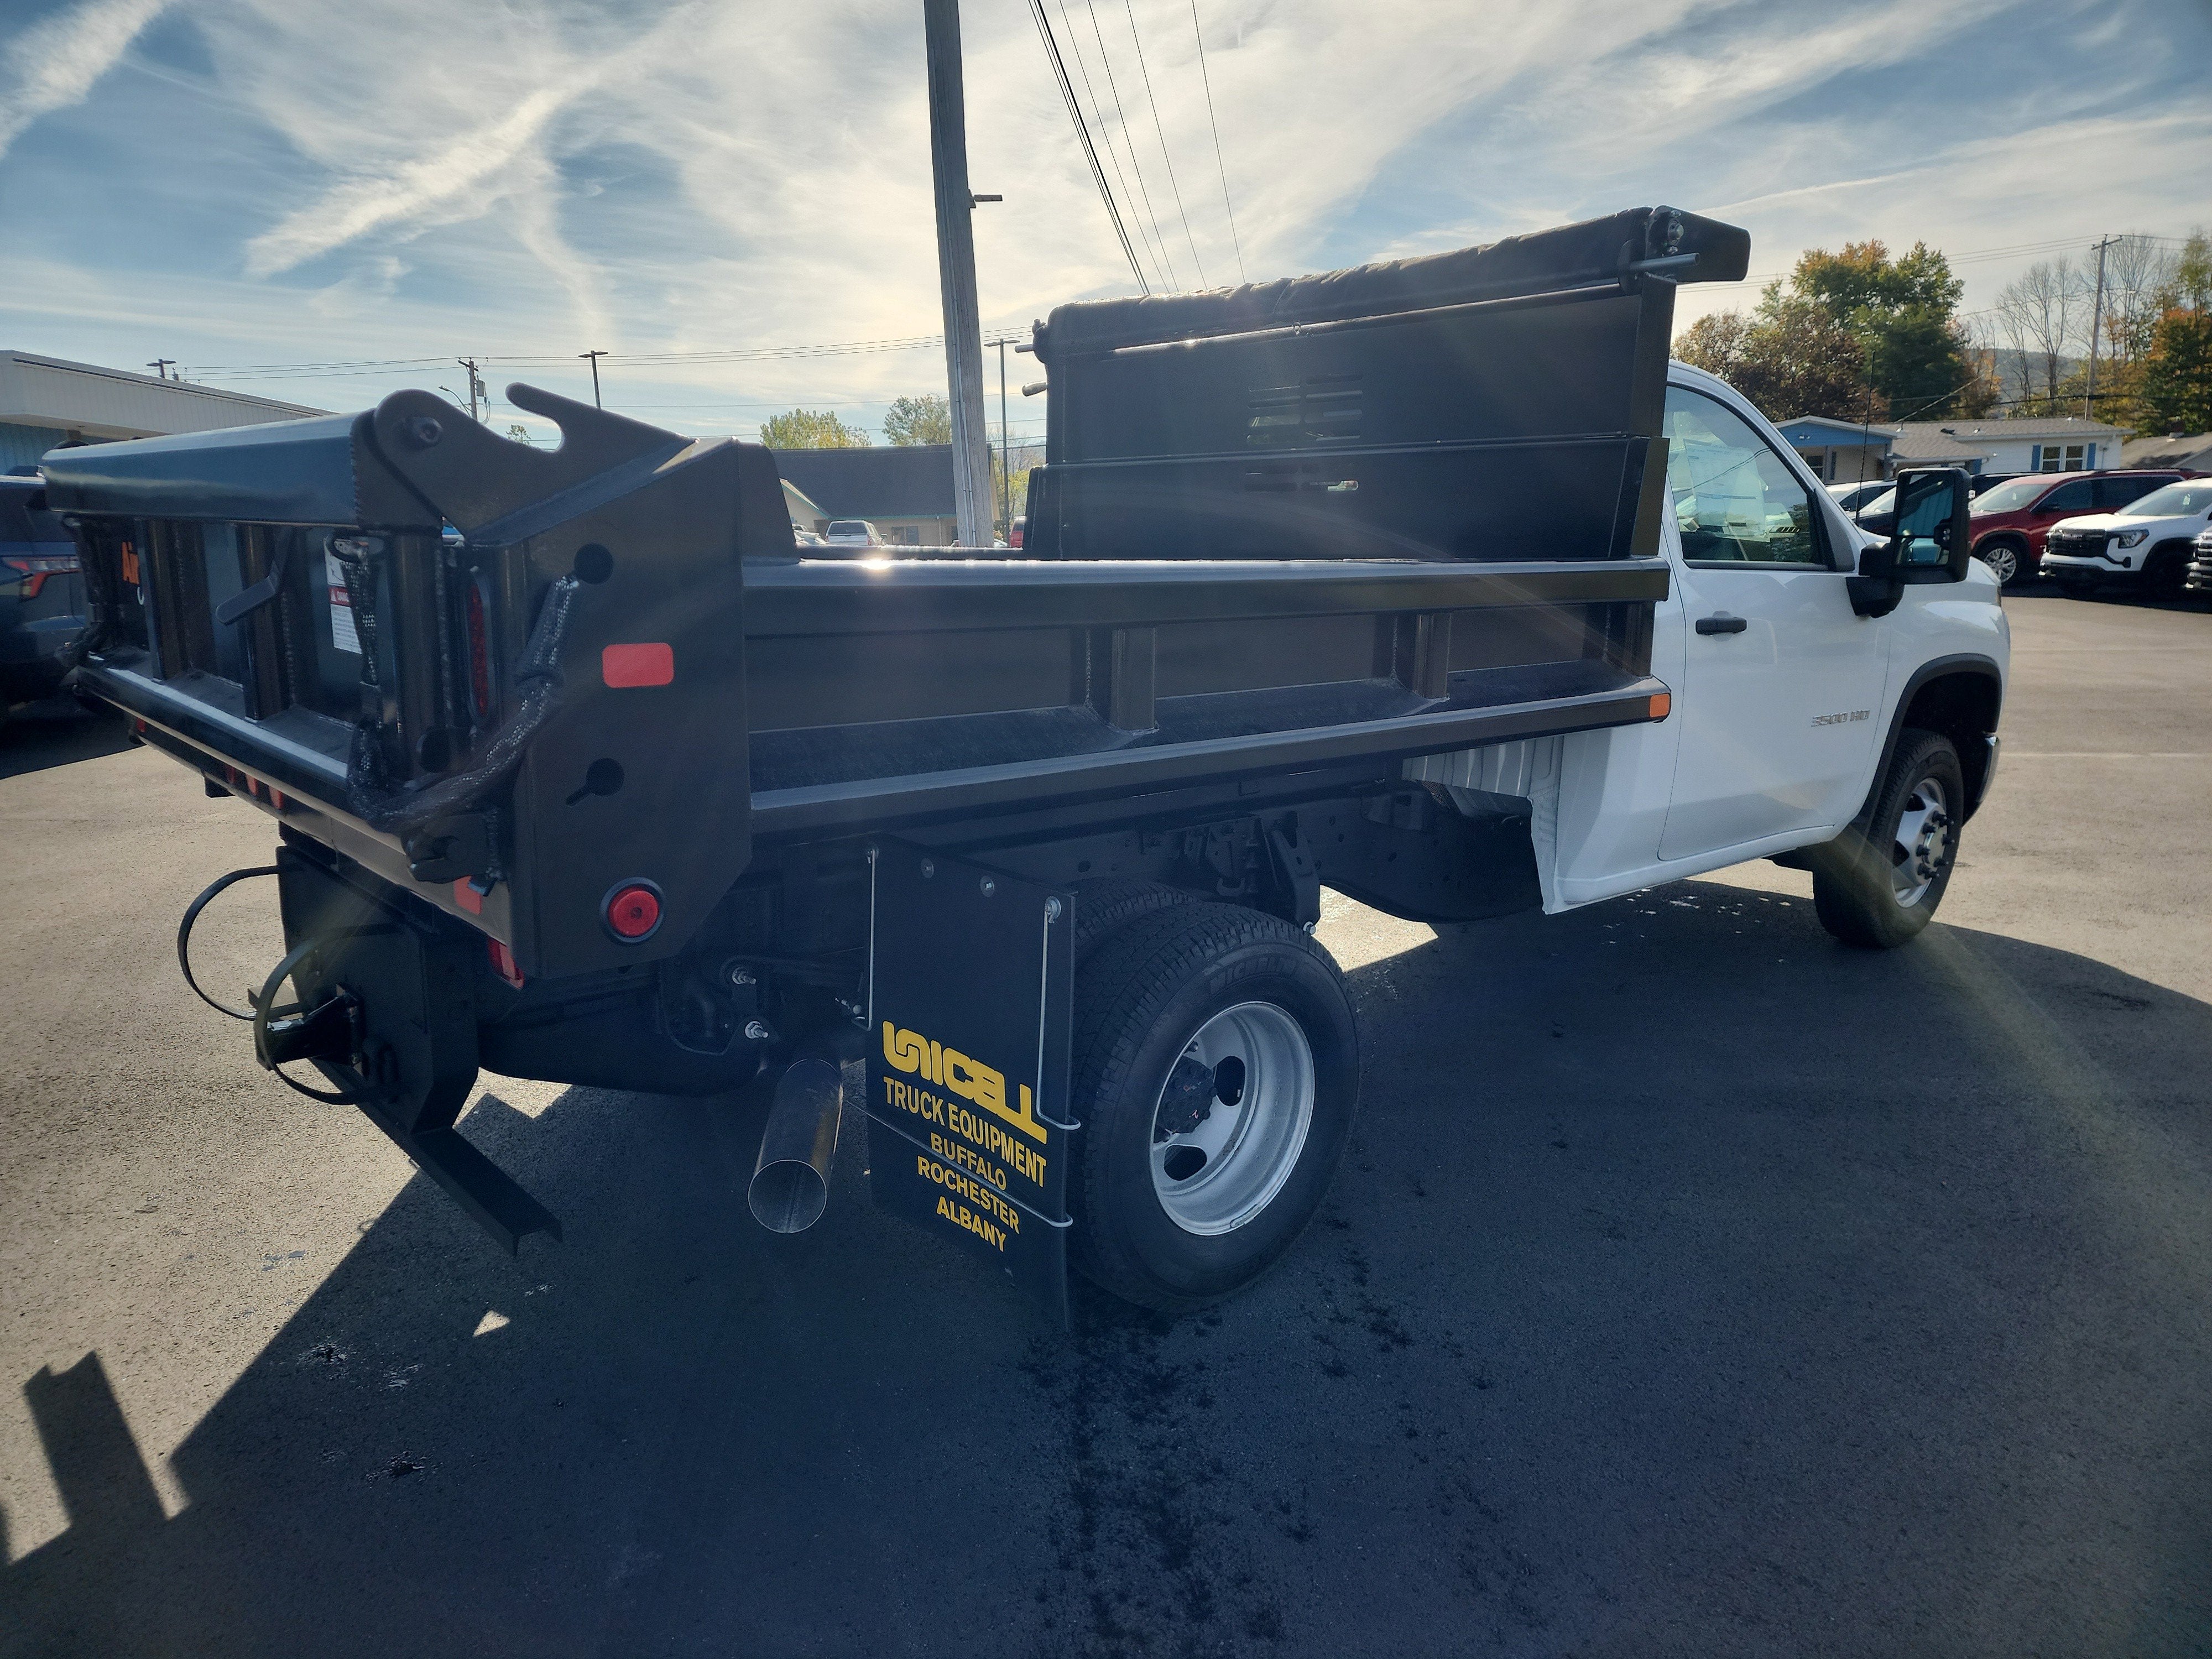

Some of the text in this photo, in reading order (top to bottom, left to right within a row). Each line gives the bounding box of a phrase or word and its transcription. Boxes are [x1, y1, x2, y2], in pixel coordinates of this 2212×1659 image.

[1811, 709, 1870, 727] 3500 HD
[883, 1020, 1047, 1144] UNICELL
[883, 1077, 1047, 1187] TRUCK EQUIPMENT
[930, 1133, 1006, 1191] BUFFALO
[917, 1156, 1020, 1234] ROCHESTER
[937, 1196, 1006, 1253] ALBANY
